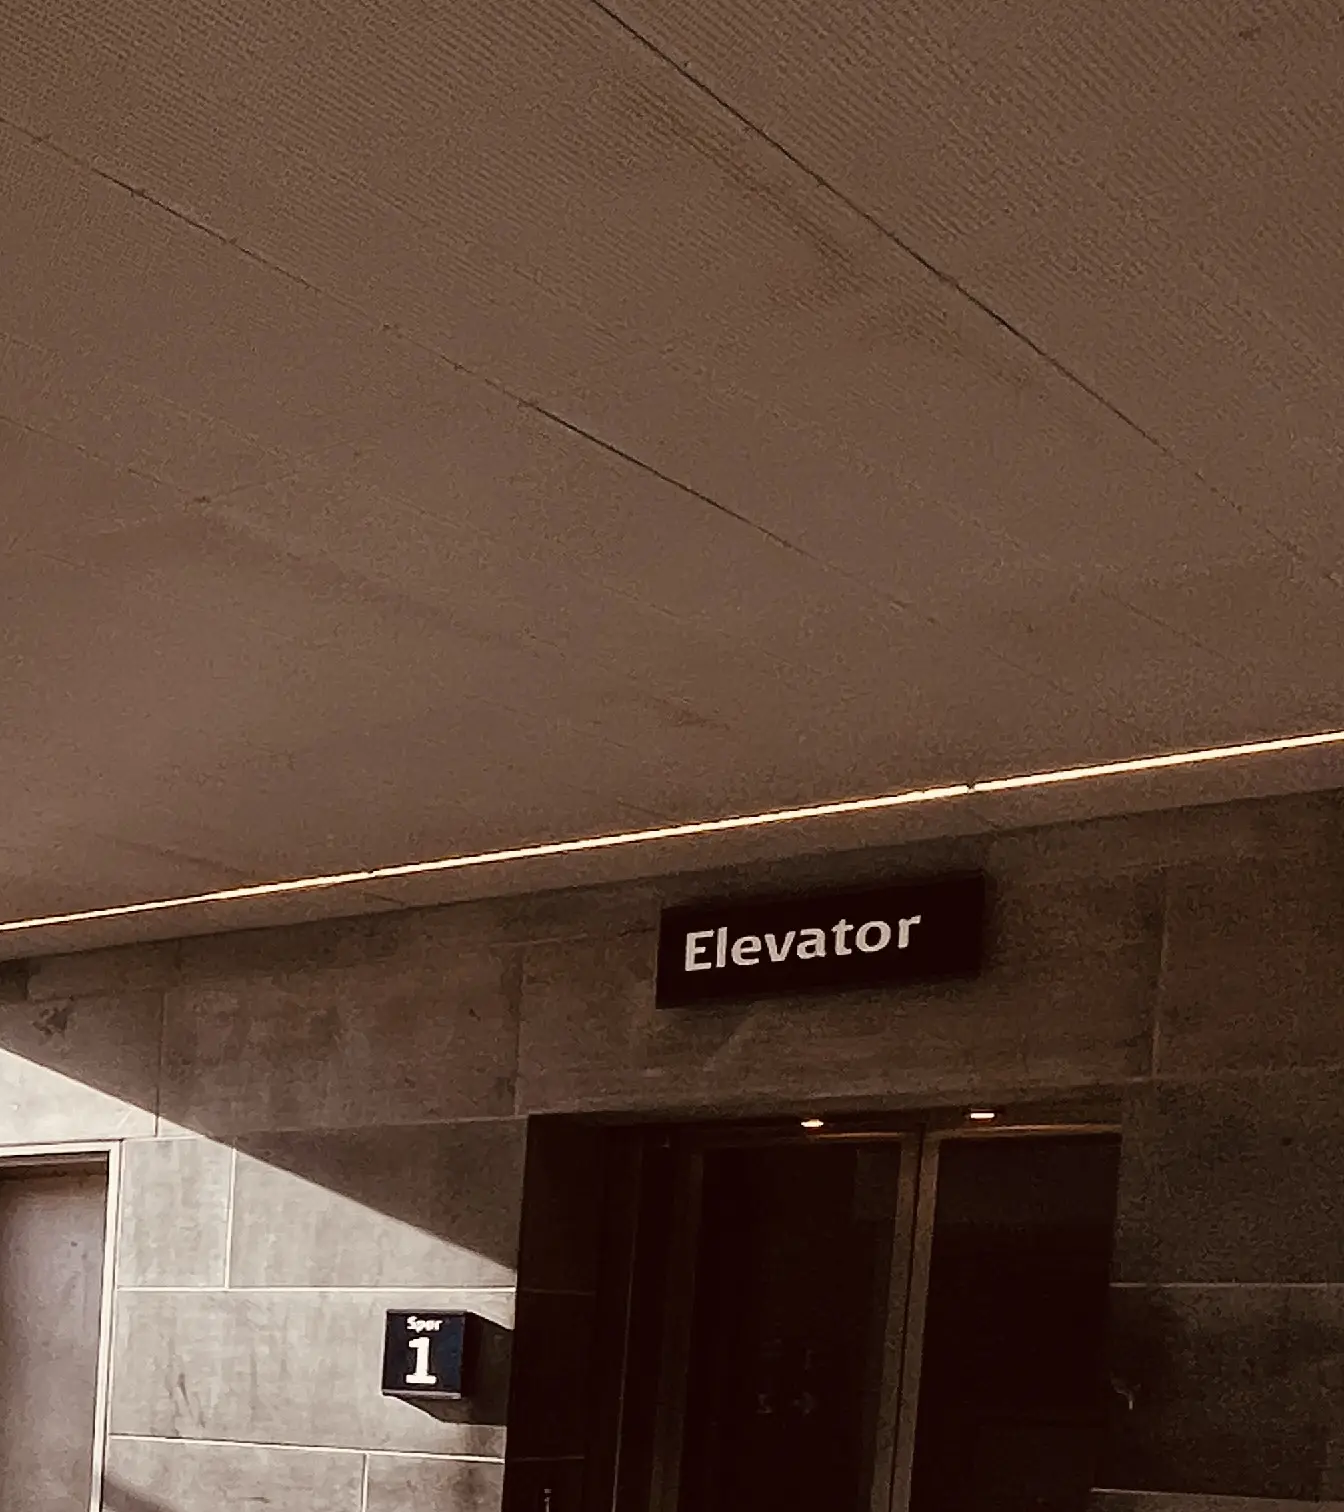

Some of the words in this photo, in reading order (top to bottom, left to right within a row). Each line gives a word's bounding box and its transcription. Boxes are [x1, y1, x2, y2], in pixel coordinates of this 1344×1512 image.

[685, 915, 921, 971] Elevator
[406, 1315, 443, 1334] Spor
[405, 1336, 437, 1384] 1
